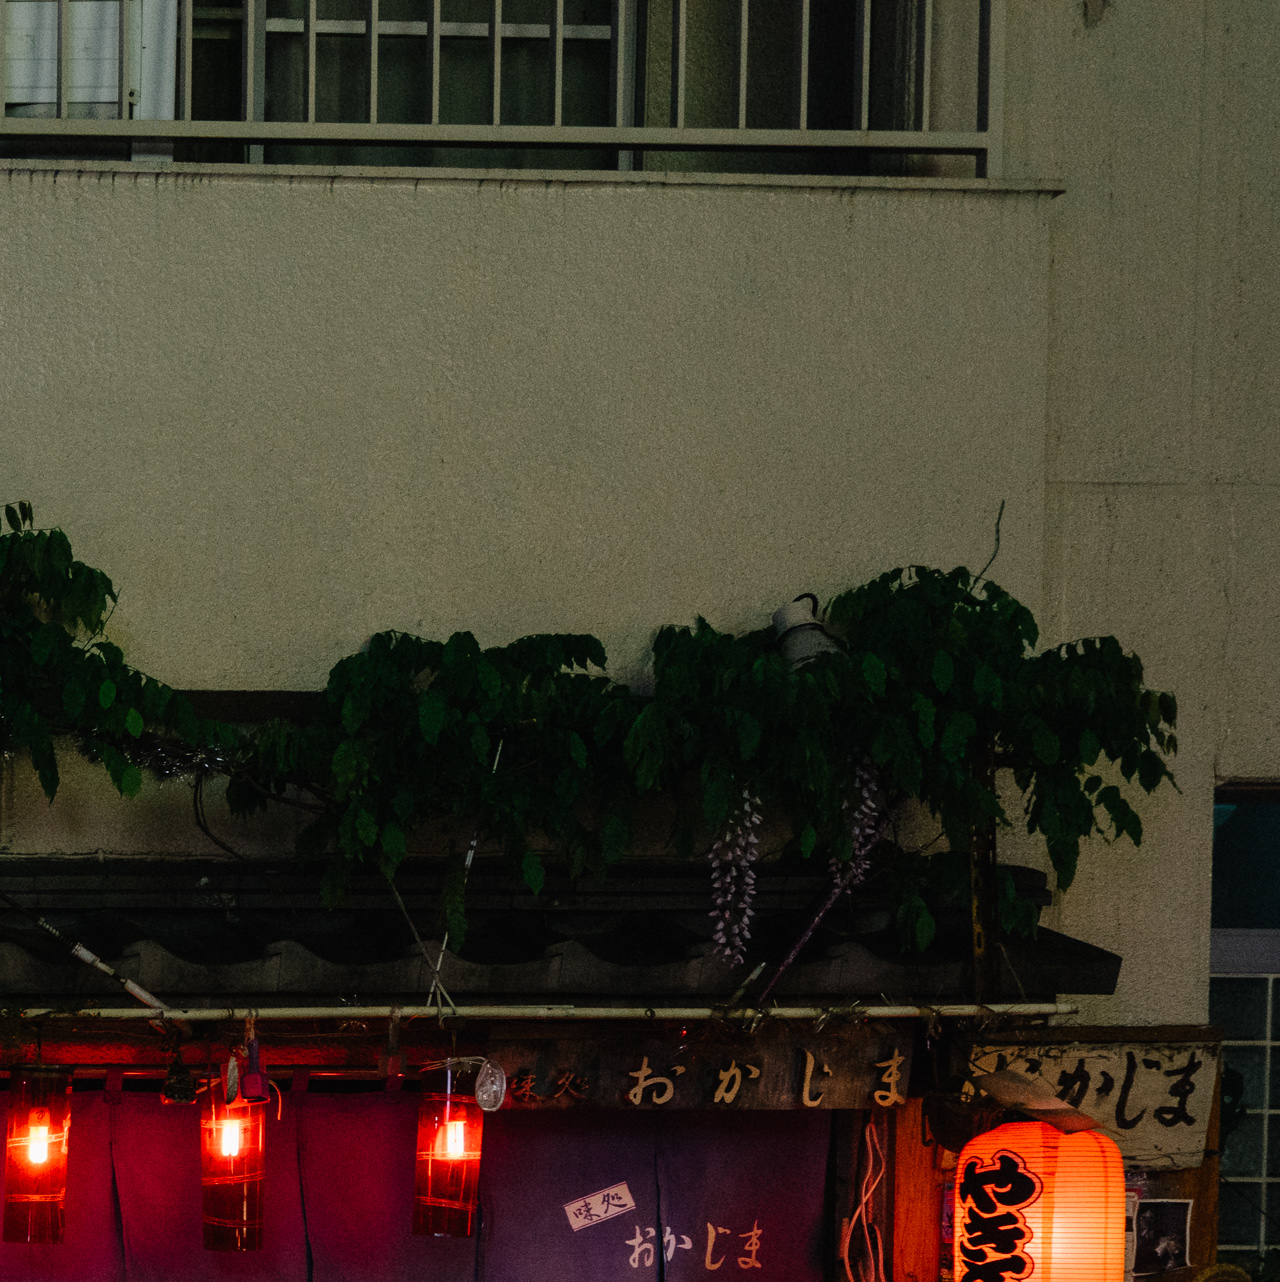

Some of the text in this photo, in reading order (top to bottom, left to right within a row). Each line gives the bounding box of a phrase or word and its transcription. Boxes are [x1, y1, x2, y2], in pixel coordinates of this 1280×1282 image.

[628, 1047, 907, 1107] おかじま
[988, 1052, 1202, 1129] かじま
[573, 1189, 628, 1222] 味処
[626, 1220, 764, 1270] おかじま
